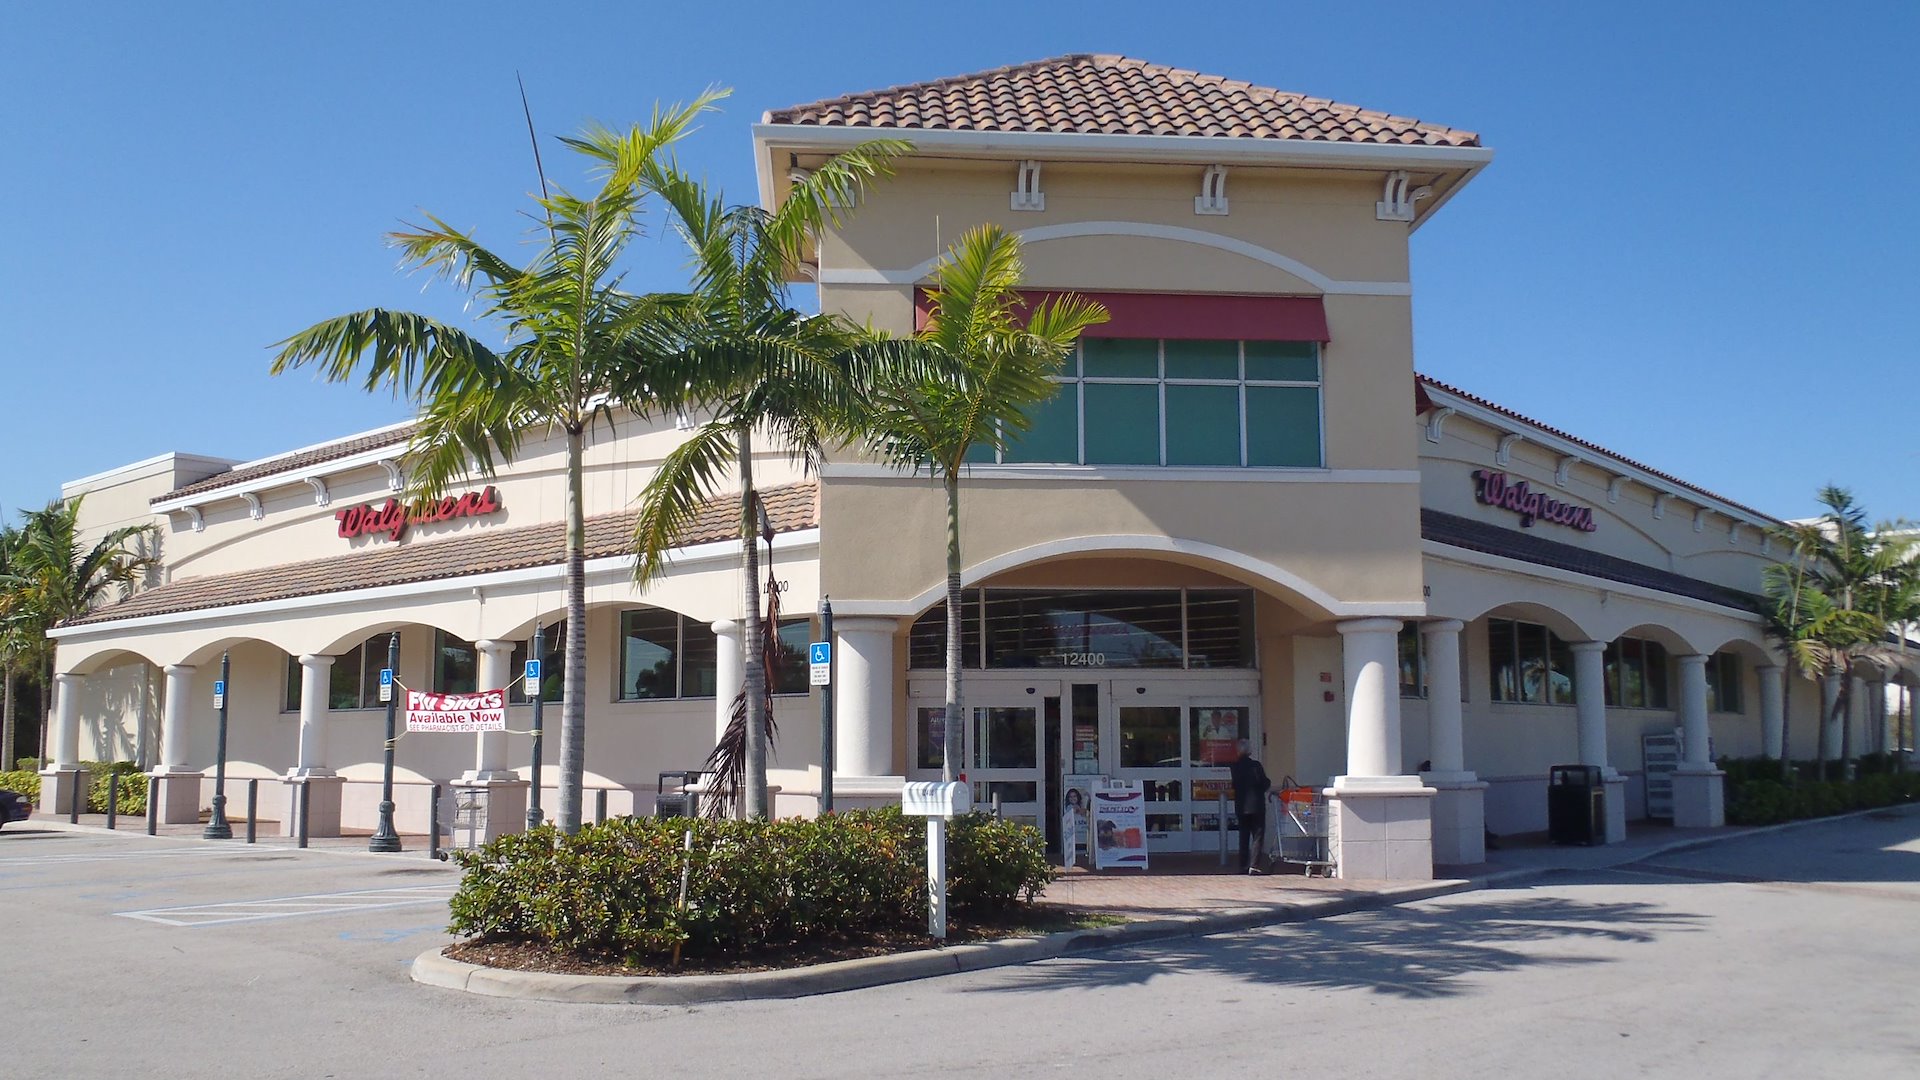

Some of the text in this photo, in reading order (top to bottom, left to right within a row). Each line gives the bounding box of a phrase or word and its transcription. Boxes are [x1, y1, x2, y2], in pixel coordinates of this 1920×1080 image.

[1471, 468, 1597, 532] Walgreens
[763, 580, 788, 594] 100
[1062, 652, 1105, 666] 12400
[408, 690, 438, 711] Flu
[440, 692, 502, 711] Shots
[410, 711, 501, 724] Available Now
[421, 724, 459, 732] PHARMACIST
[476, 723, 503, 731] DETAILS
